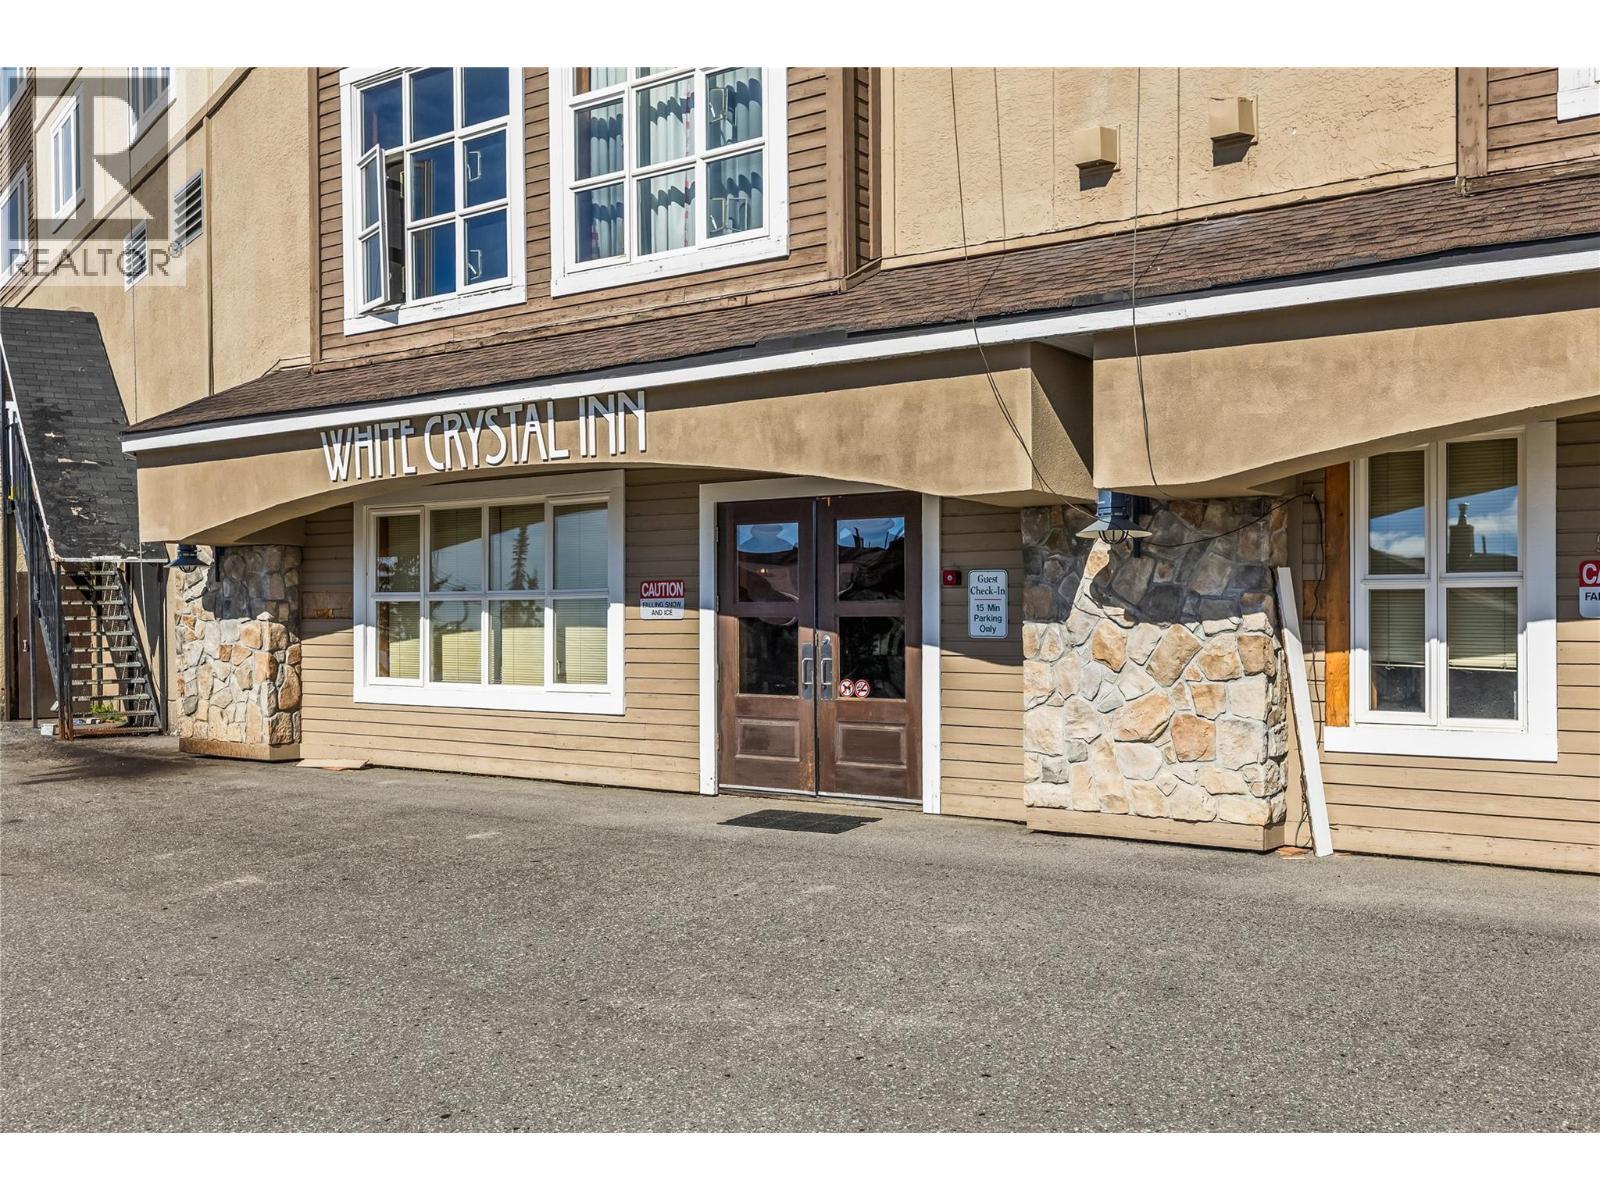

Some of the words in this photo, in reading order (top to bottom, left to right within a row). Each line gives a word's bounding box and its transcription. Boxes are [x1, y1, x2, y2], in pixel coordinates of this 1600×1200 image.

[320, 420, 417, 481] WHITE
[424, 401, 570, 472] CRYSTAL
[579, 391, 646, 457] INN
[977, 574, 998, 583] Guest
[1582, 563, 1600, 584] C
[641, 582, 684, 597] CAUTION
[970, 585, 1006, 595] Check-In
[976, 604, 984, 612] 15
[987, 604, 1000, 612] Min
[973, 614, 1002, 623] Parking
[979, 624, 996, 634] Only
